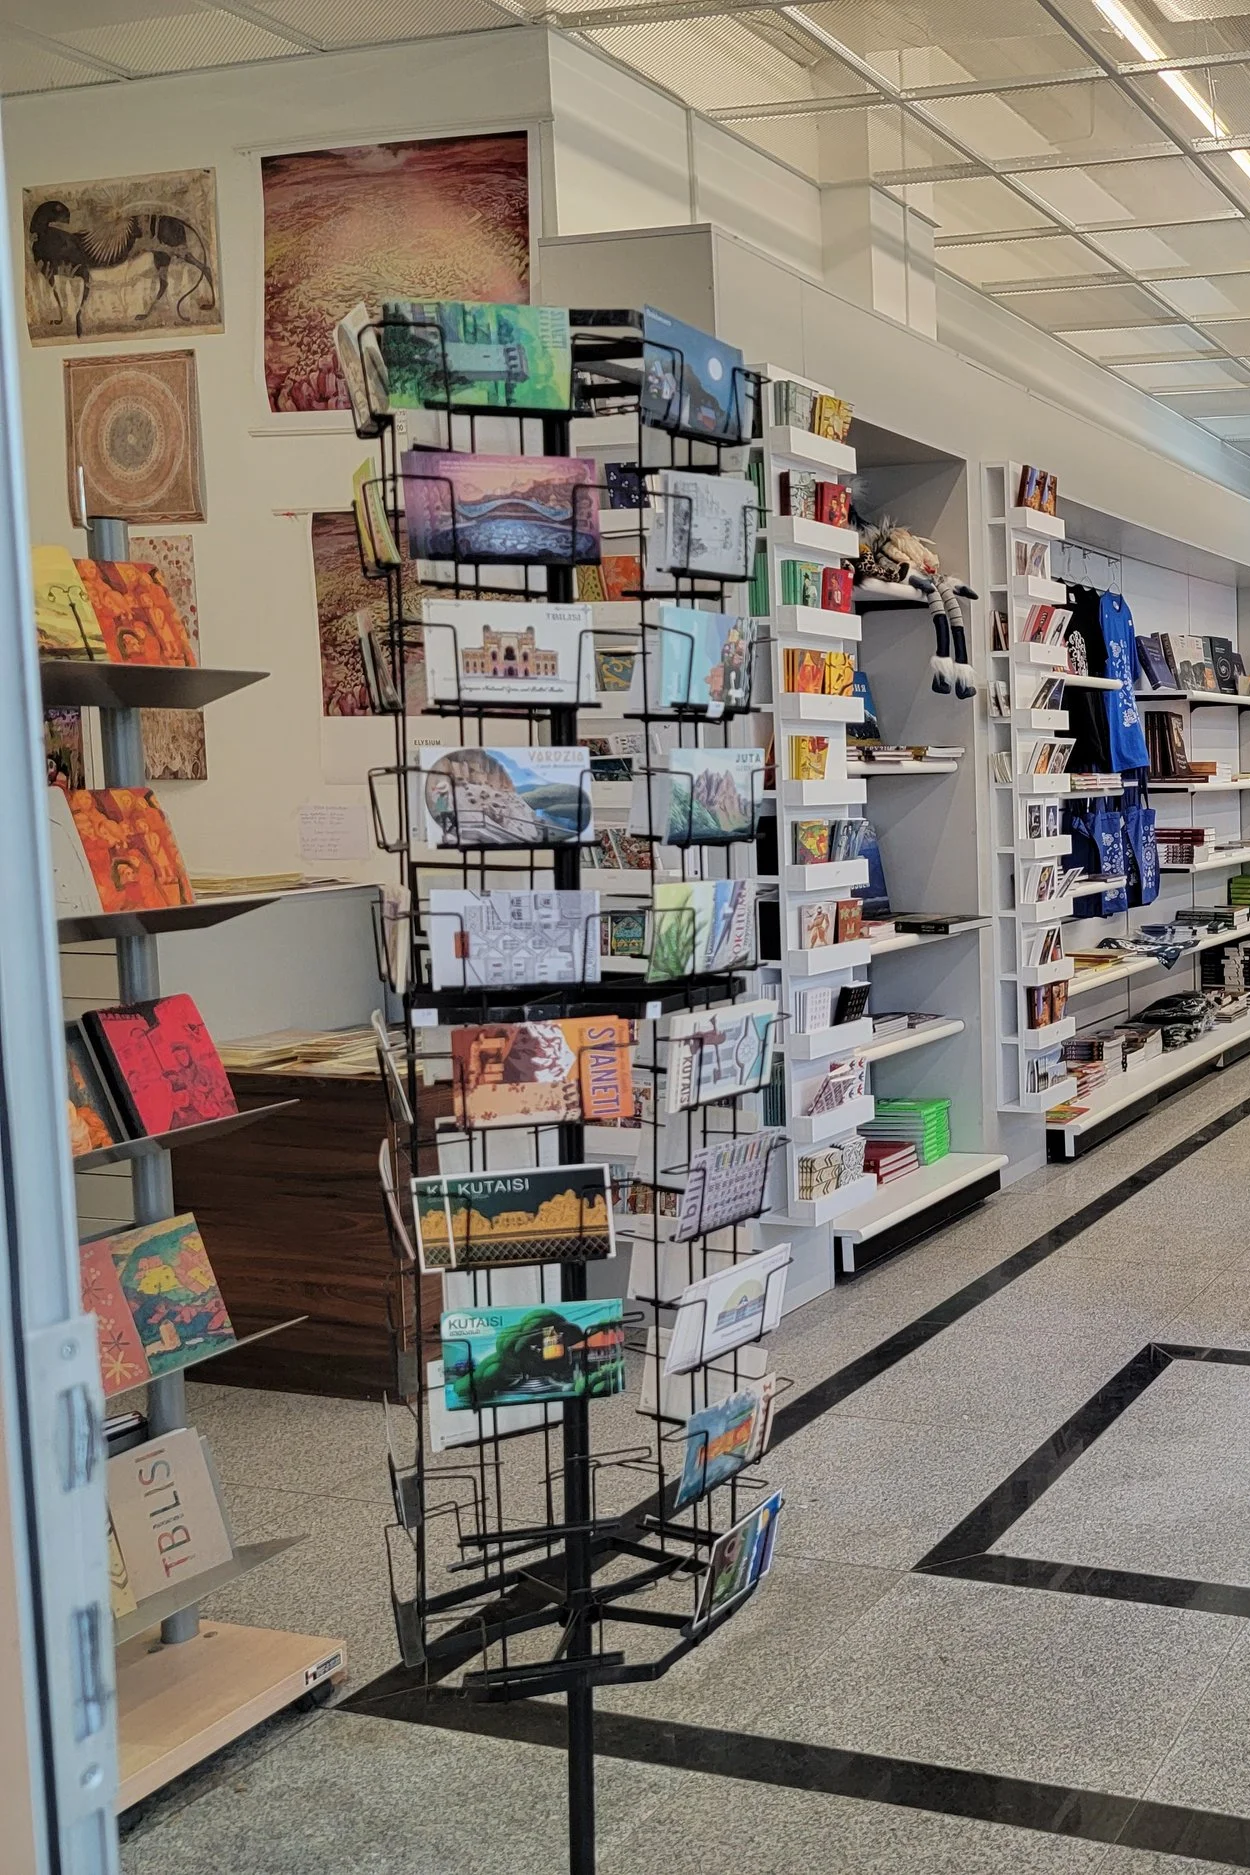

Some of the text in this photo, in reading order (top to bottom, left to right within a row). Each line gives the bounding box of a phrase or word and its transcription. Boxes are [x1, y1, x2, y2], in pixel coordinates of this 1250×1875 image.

[528, 750, 585, 762] VARDZIA
[735, 753, 761, 763] JUTA
[588, 1027, 620, 1115] SVANETI
[457, 1177, 530, 1196] KUTAISI
[448, 1315, 503, 1330] KUTAISI
